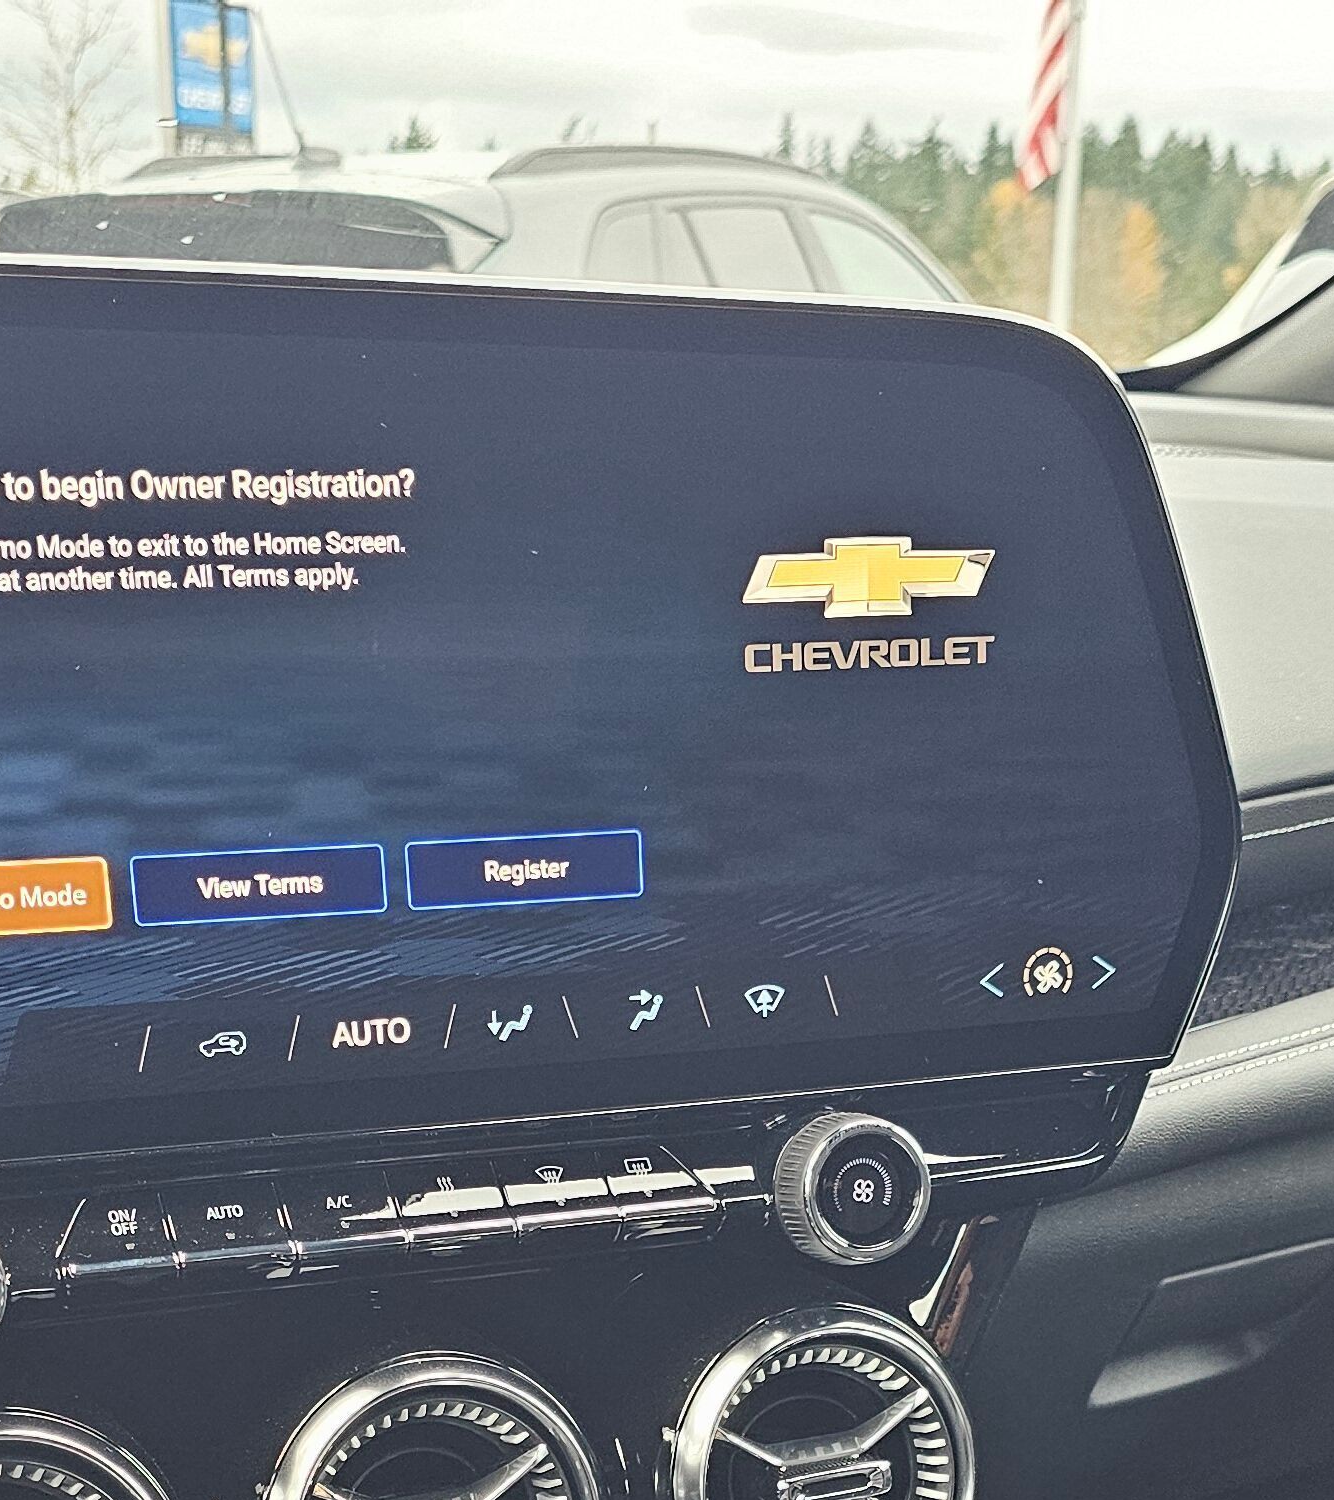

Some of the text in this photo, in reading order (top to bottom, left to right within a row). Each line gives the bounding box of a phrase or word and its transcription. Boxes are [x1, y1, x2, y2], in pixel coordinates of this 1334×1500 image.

[1, 472, 34, 501] to
[40, 468, 124, 507] begin
[131, 469, 226, 500] Owner
[231, 468, 415, 505] Registration?
[37, 533, 104, 559] Mode
[107, 536, 132, 557] to
[137, 533, 181, 557] exit
[183, 534, 208, 556] to
[211, 532, 249, 556] the
[254, 532, 321, 555] Home
[325, 531, 406, 554] Screen.
[25, 566, 114, 592] another
[118, 566, 178, 590] time.
[183, 564, 213, 588] All
[217, 564, 289, 588] Terms
[294, 562, 359, 591] apply.
[744, 636, 995, 673] CHEVROLET
[484, 859, 570, 887] Register
[20, 883, 87, 908] Mode
[197, 874, 323, 899] View Terms
[332, 1017, 411, 1048] AUTO
[206, 1204, 244, 1221] AUTO
[326, 1195, 353, 1210] A/C
[107, 1208, 137, 1224] ON/
[110, 1222, 139, 1236] OFF
